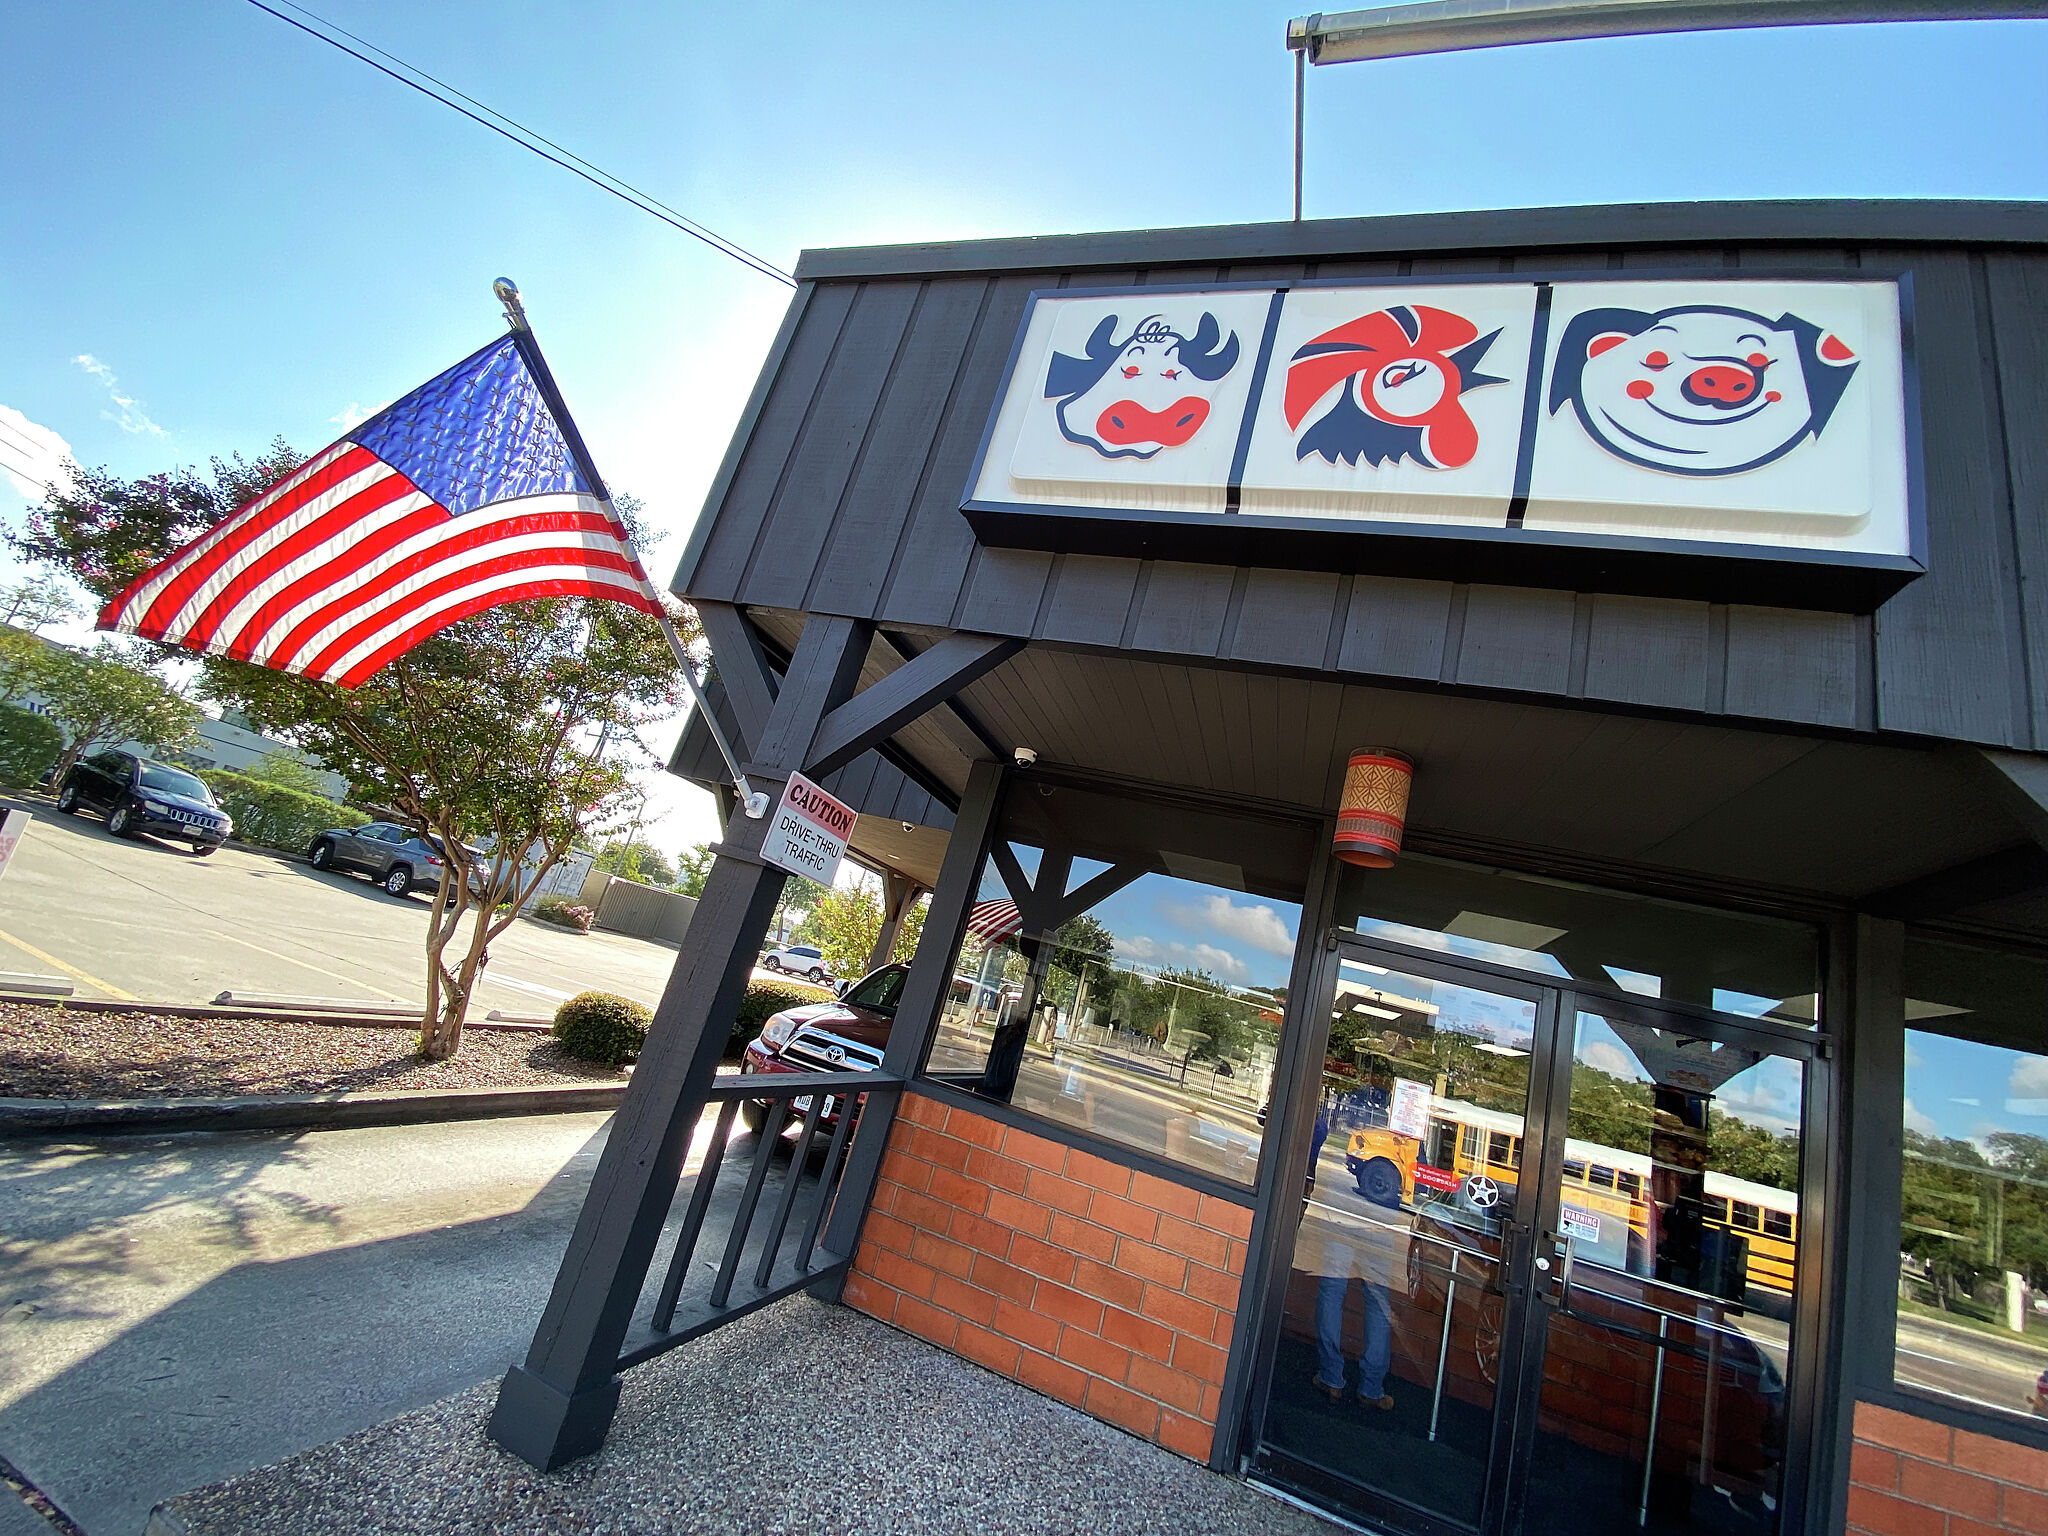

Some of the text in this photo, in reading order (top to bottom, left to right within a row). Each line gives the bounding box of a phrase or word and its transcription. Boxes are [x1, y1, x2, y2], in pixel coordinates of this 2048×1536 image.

[790, 784, 852, 833] CAUTION
[780, 816, 840, 858] DRIVE-THRU
[785, 840, 825, 871] TRAFFIC
[1422, 1174, 1457, 1188] DOORDASH
[1565, 1210, 1598, 1228] WARNING
